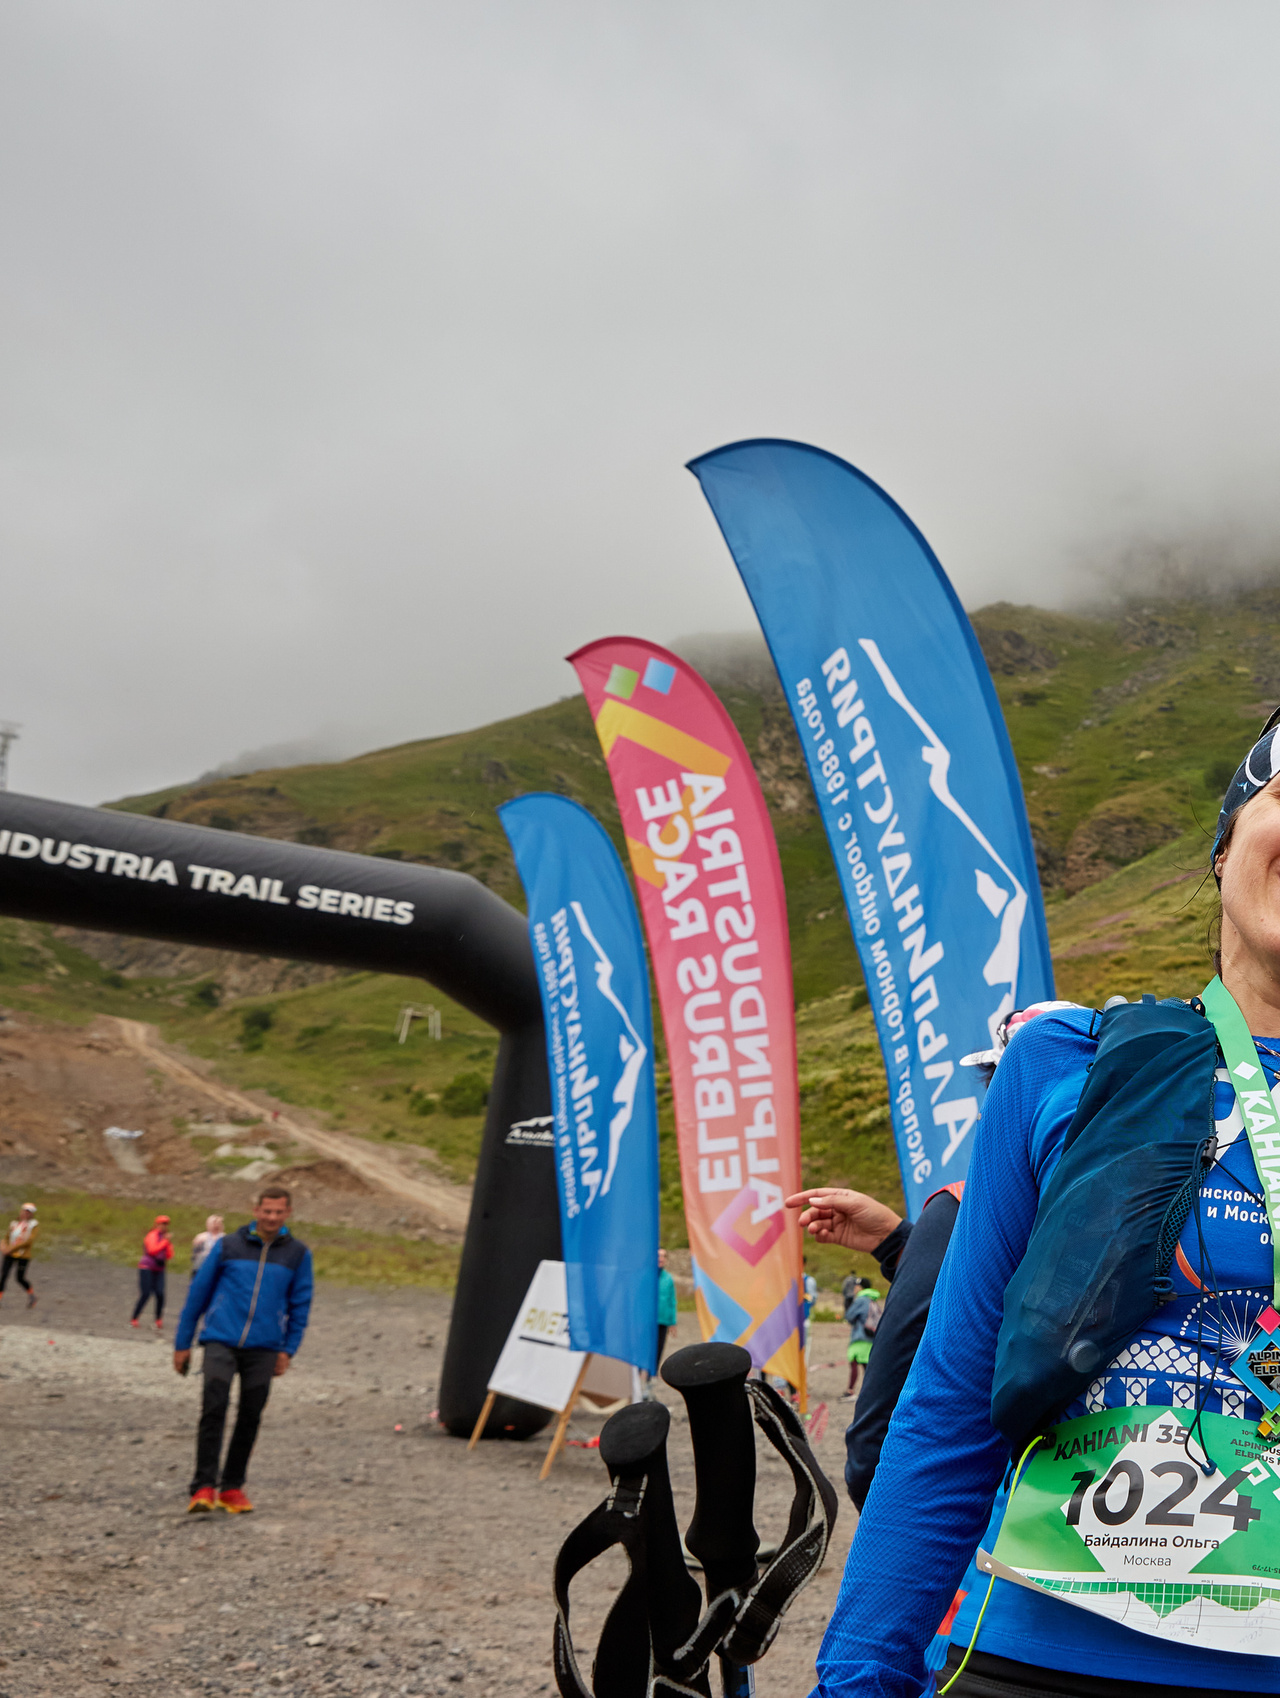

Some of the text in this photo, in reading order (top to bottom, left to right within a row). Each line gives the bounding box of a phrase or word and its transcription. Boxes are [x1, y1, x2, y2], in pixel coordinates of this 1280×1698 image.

[187, 863, 290, 905] TRAIL
[296, 884, 415, 925] SERIES
[1207, 1206, 1218, 1218] и
[1053, 1423, 1190, 1461] KAHIANI 35
[1235, 1449, 1275, 1464] ELBRUS
[1065, 1459, 1261, 1532] 1024
[1084, 1533, 1220, 1549] Байдалина Ольга
[1123, 1554, 1172, 1567] Москва
